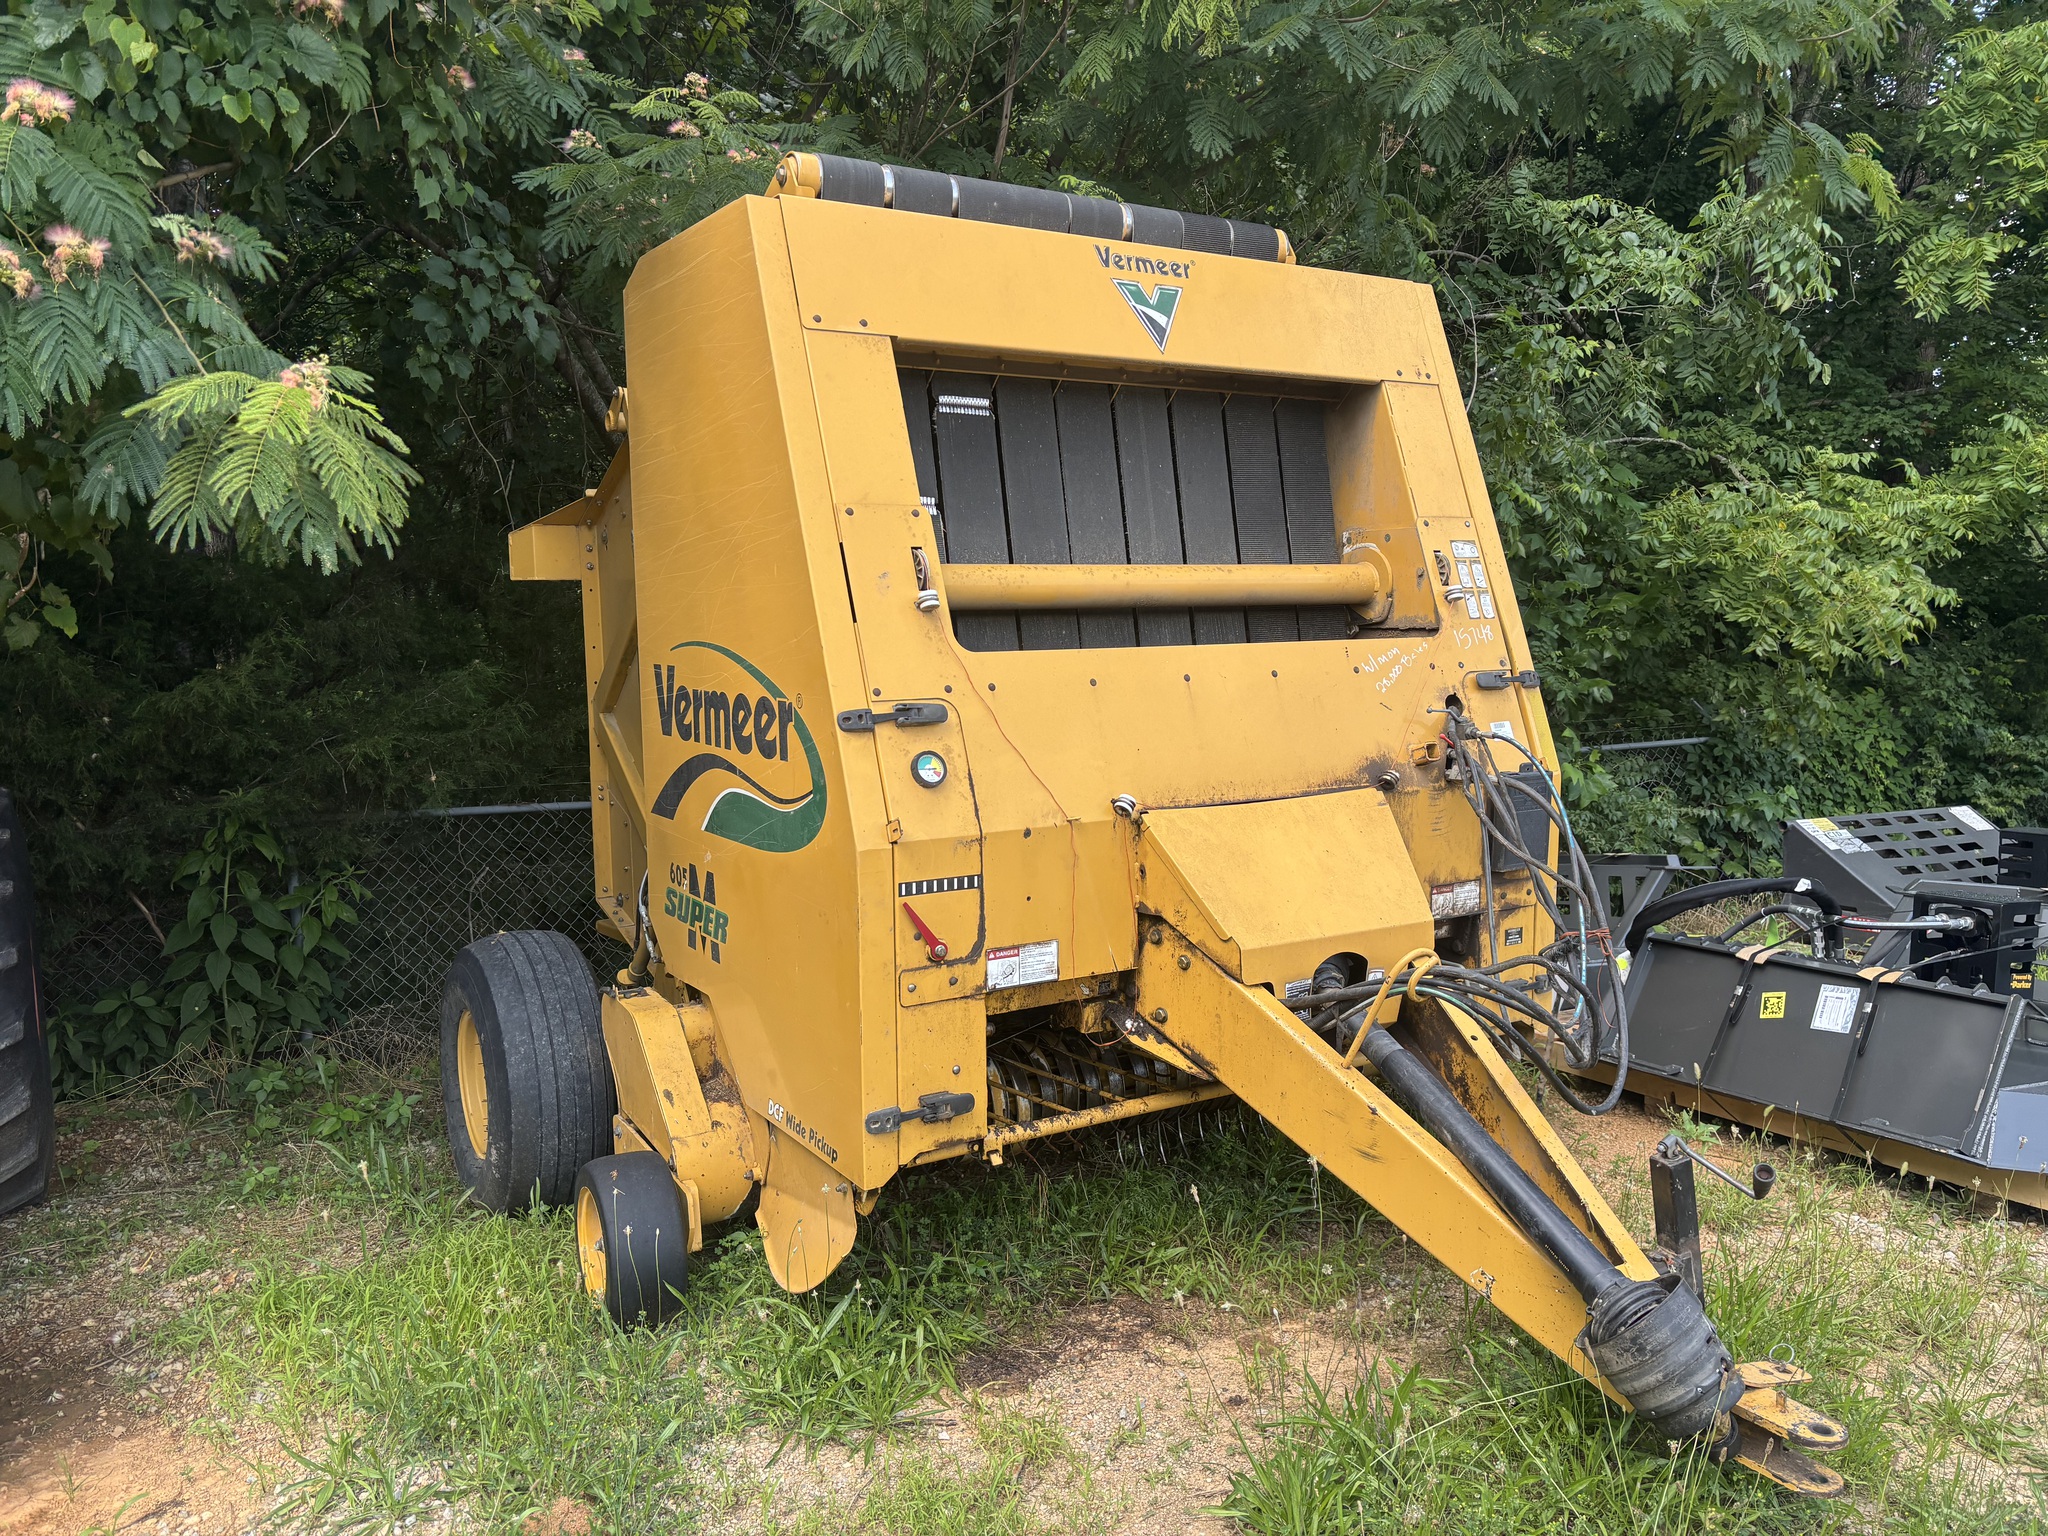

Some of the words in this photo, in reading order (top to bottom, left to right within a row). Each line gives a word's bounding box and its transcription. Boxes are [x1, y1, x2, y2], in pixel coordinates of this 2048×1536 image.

[1093, 244, 1190, 279] Vermeer
[1453, 624, 1494, 650] 15748
[653, 663, 794, 763] Vermeer
[664, 886, 729, 945] SUPER
[995, 949, 1018, 958] DANGER
[768, 1097, 784, 1122] DCF
[785, 1110, 807, 1140] Wide
[808, 1127, 839, 1163] Pickup
